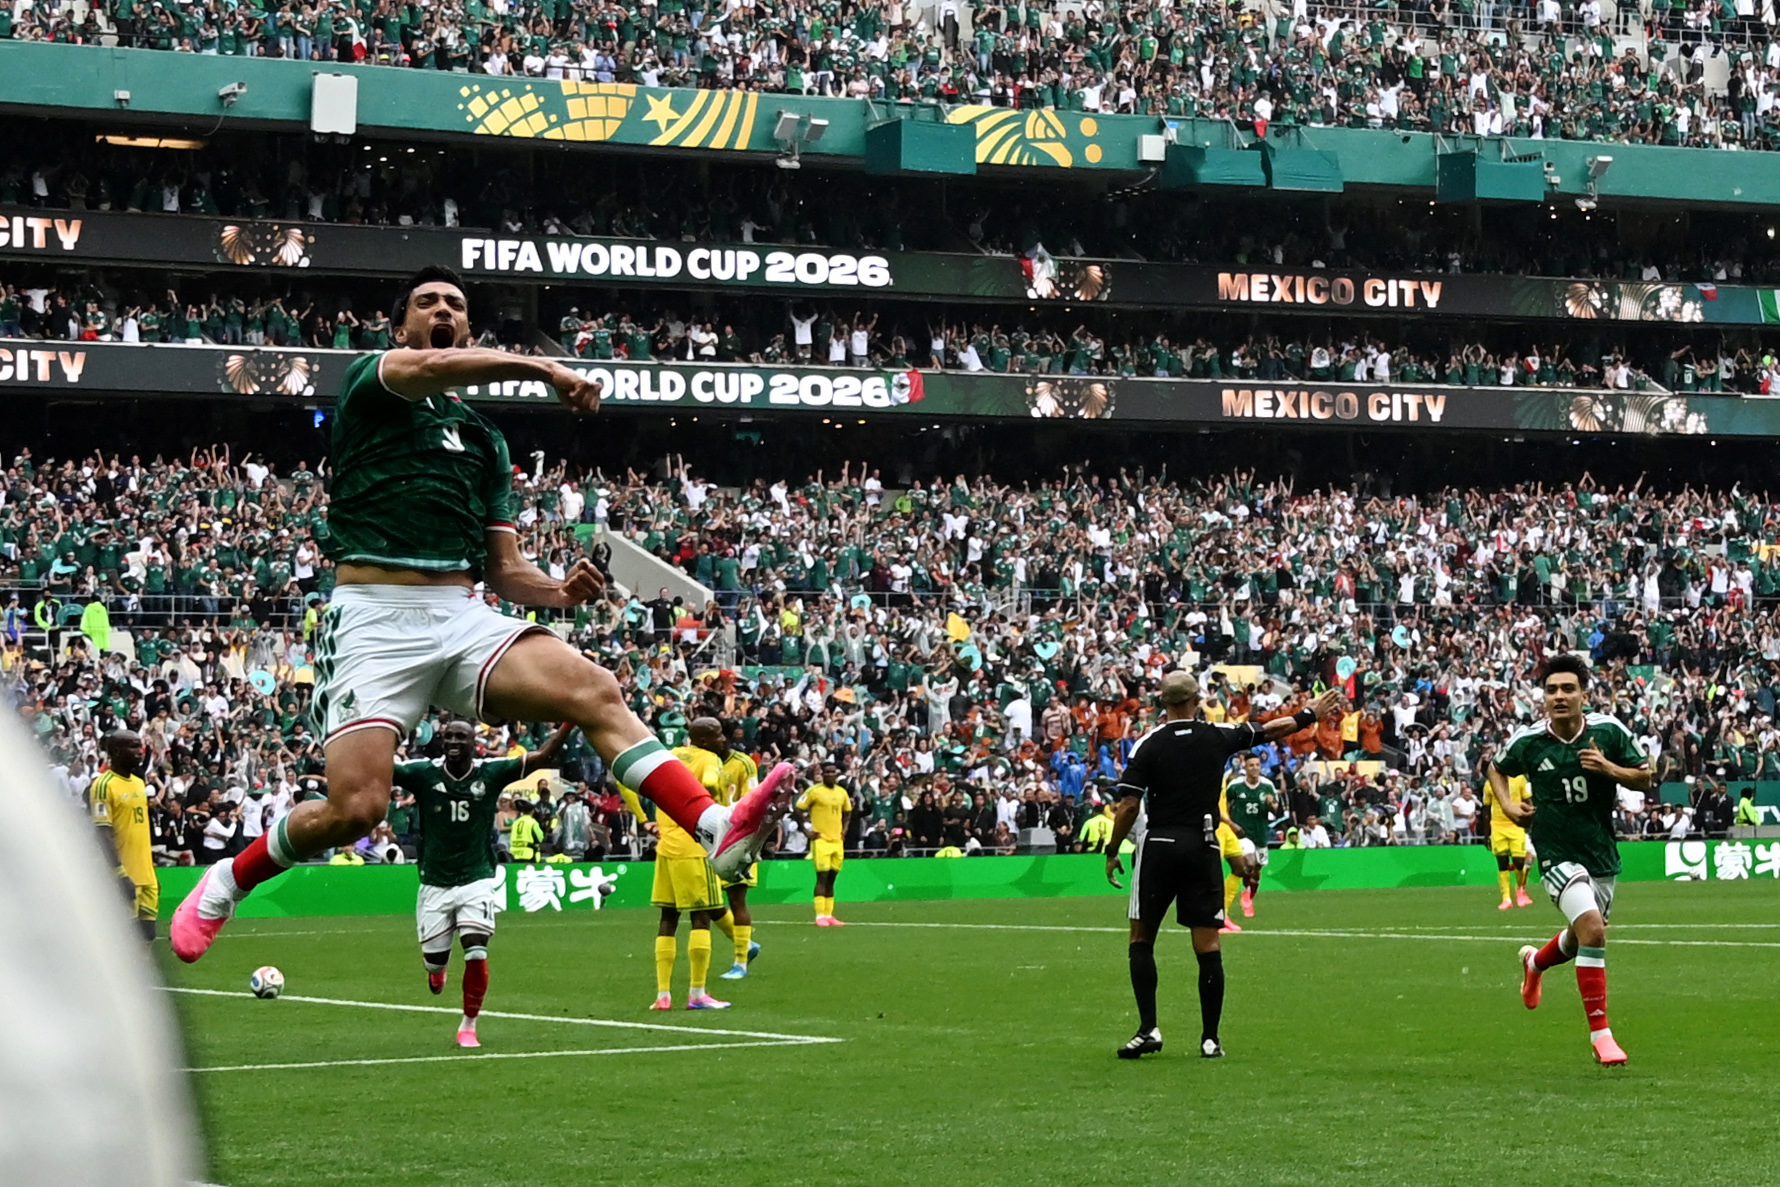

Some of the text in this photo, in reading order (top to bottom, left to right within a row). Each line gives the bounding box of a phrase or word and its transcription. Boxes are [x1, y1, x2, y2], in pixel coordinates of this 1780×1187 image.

[461, 238, 890, 287] FIFA WORLD CUP 2026
[1217, 272, 1443, 308] MEXICO CITY
[573, 367, 687, 401] ORLD
[691, 371, 764, 403] CUP
[769, 374, 892, 408] 2026
[1221, 389, 1447, 422] MEXICO CITY
[1561, 775, 1589, 804] 19
[133, 806, 144, 824] 19
[450, 800, 470, 822] 16
[1245, 802, 1259, 814] 25
[516, 864, 618, 912] 蒙牛
